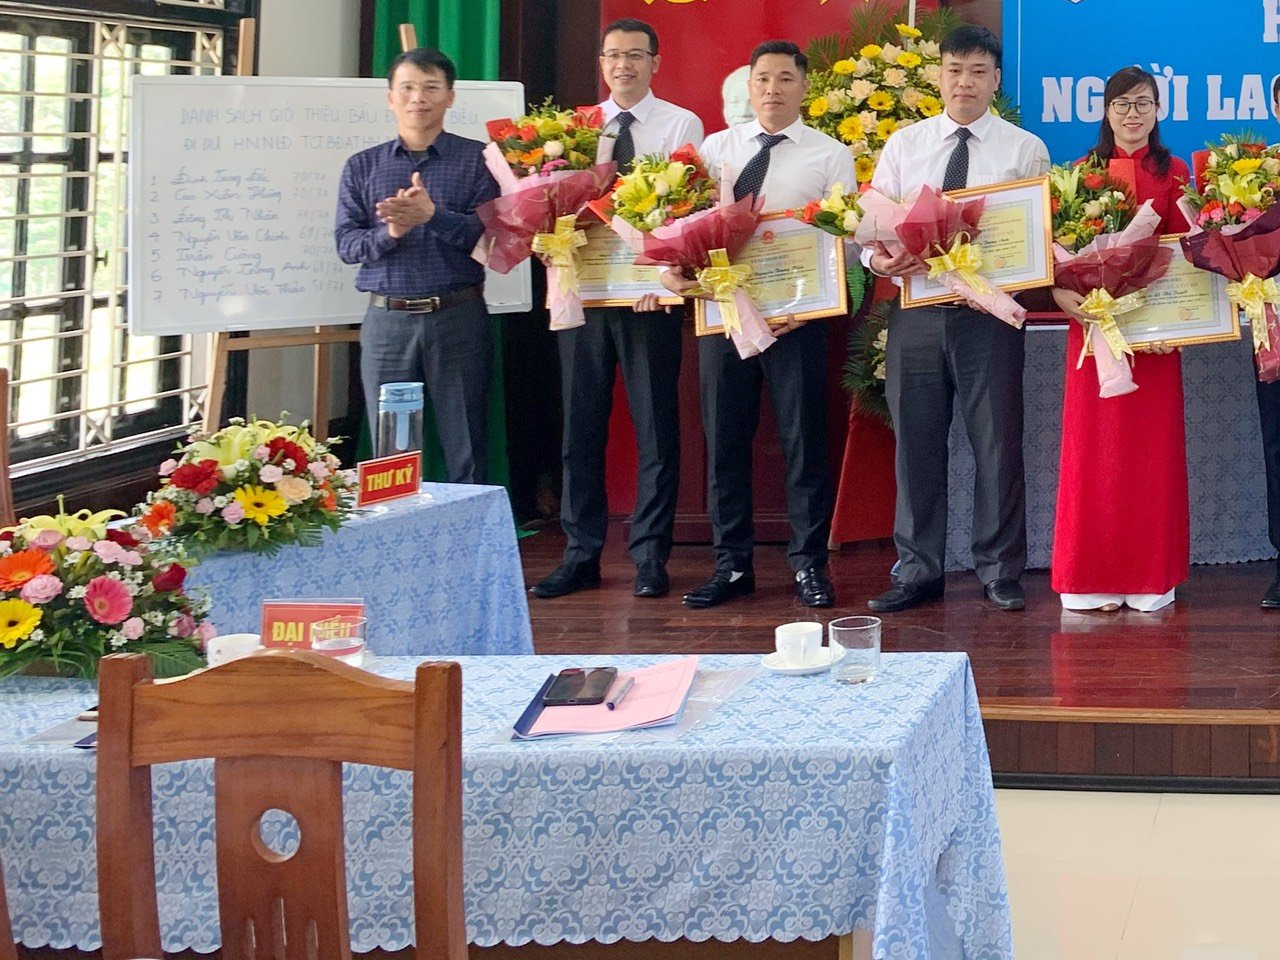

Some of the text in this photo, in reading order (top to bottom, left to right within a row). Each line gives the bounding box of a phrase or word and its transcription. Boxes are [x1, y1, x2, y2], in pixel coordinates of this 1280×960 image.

[1042, 63, 1189, 123] NGỜI
[1206, 74, 1280, 120] LA
[180, 107, 220, 126] DANH
[150, 175, 156, 186] 1
[150, 190, 160, 203] 2
[149, 212, 160, 225] 3
[150, 269, 162, 282] 6
[366, 464, 414, 491] THƯ KÝ
[272, 621, 304, 646] ĐẠI
